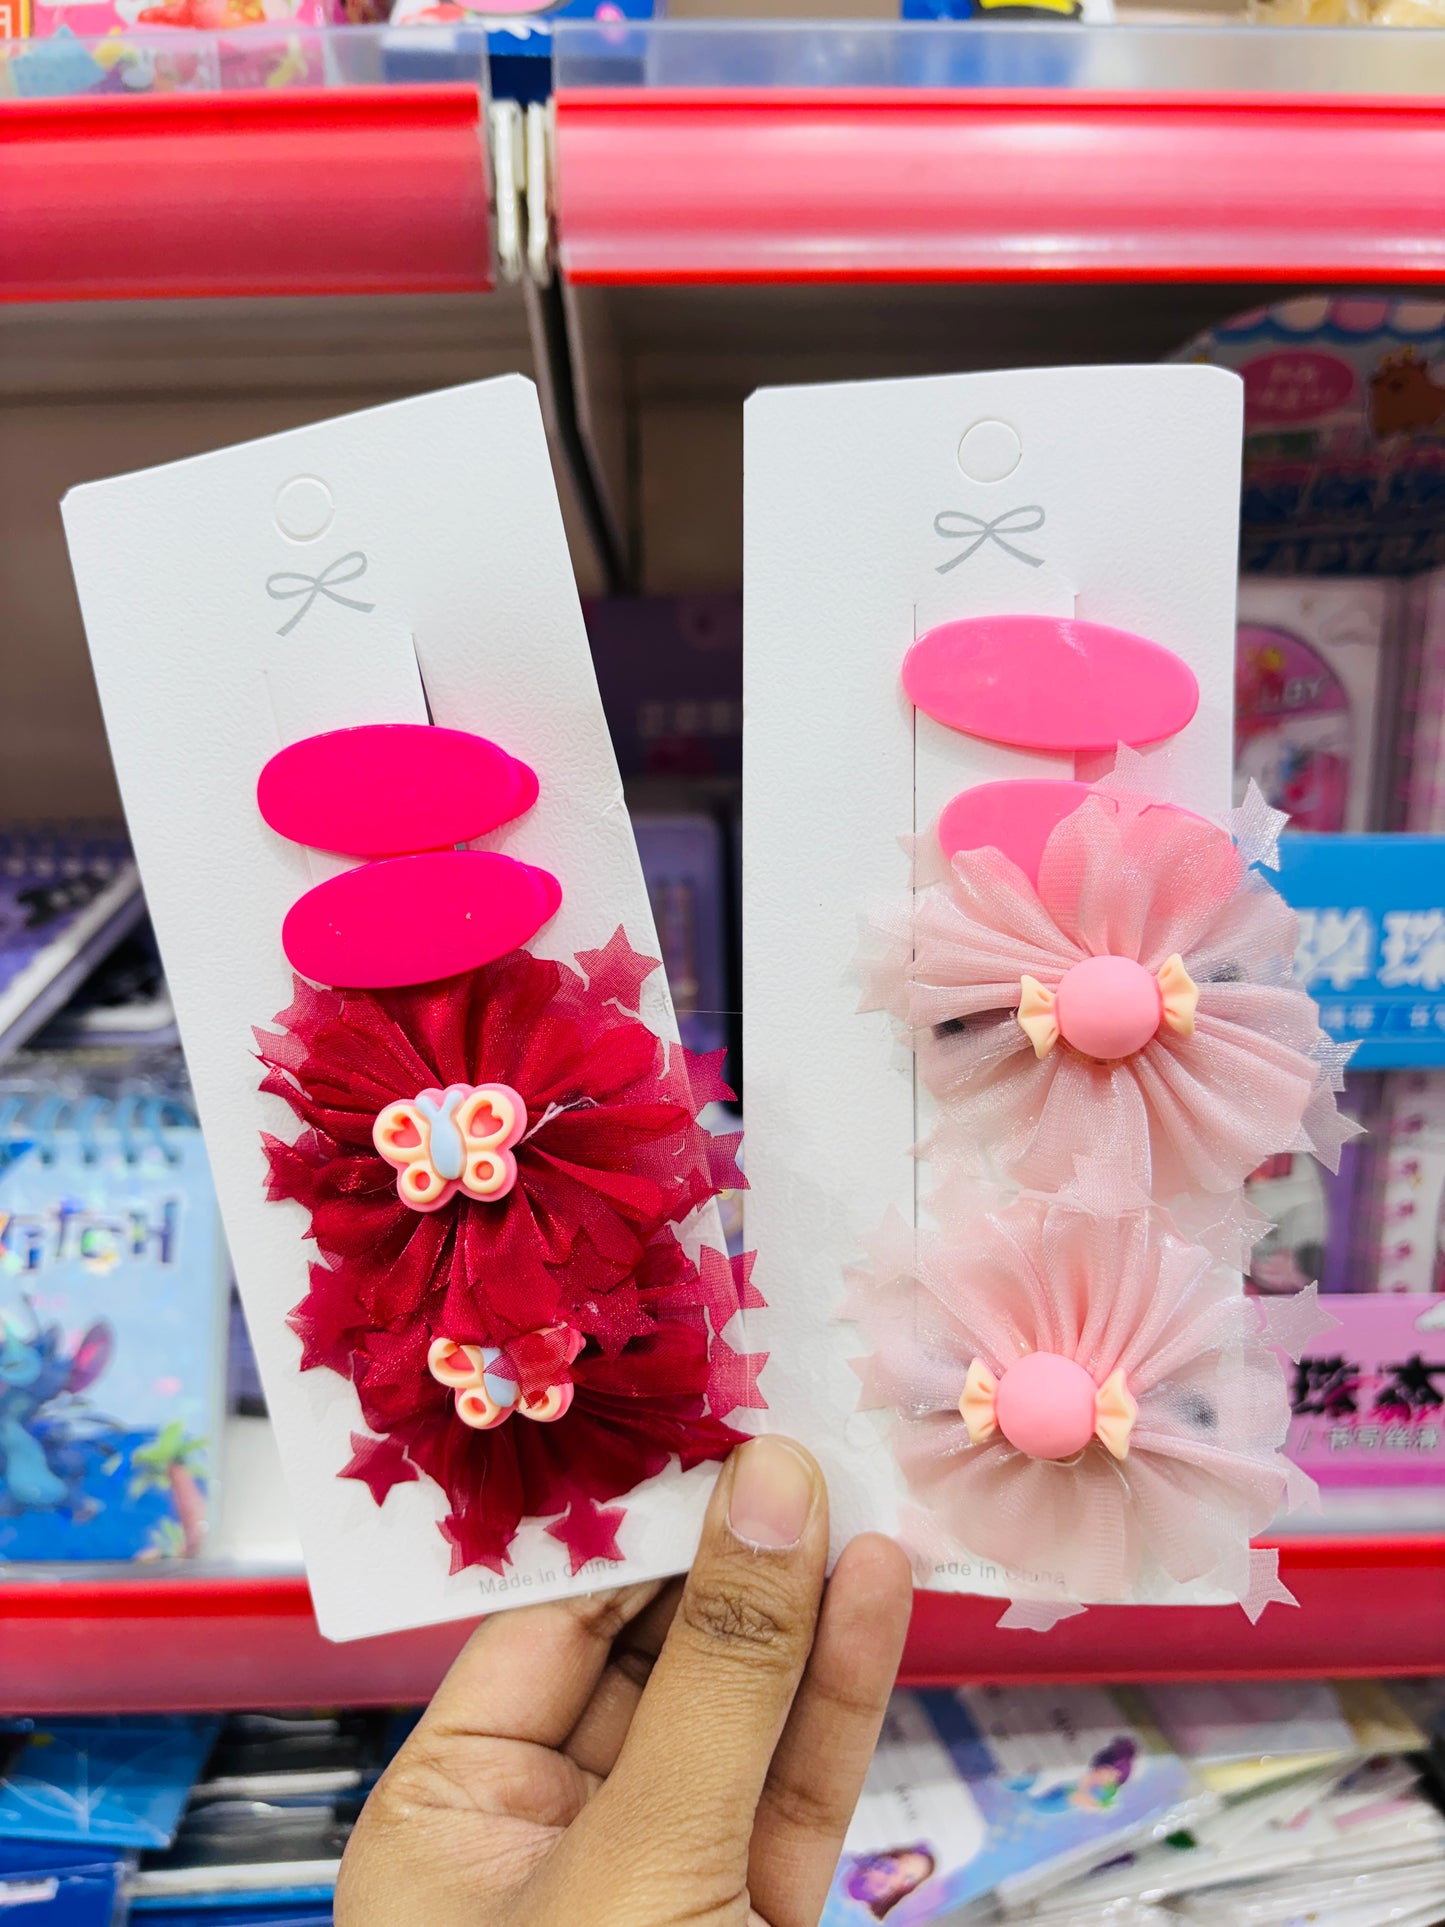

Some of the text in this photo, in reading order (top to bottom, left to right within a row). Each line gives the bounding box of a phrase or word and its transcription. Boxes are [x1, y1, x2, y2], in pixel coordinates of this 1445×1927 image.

[914, 1555, 972, 1576] Made
[979, 1560, 996, 1579] in
[478, 1573, 533, 1596] Made
[538, 1568, 557, 1584] in
